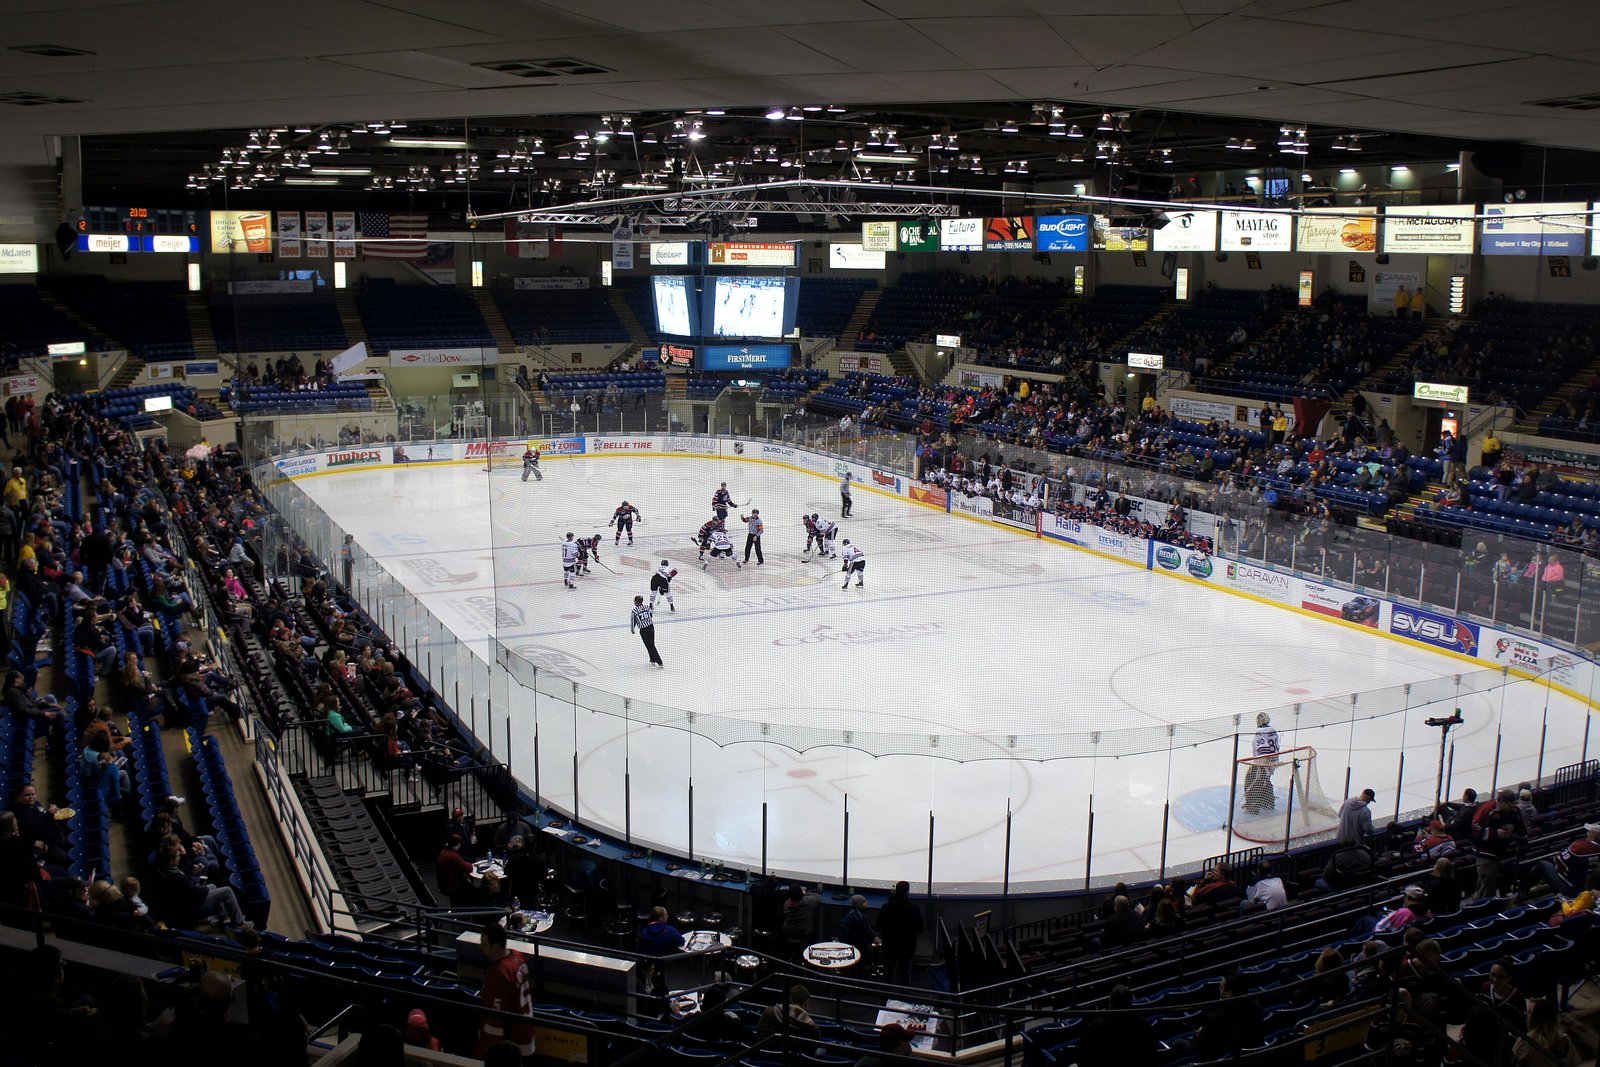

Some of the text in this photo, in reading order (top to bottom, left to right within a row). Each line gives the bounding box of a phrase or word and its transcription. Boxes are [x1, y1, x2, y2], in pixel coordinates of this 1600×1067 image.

[948, 220, 976, 233] Future
[1039, 223, 1086, 232] BUD LIGHT
[1236, 218, 1278, 231] MAYTAG
[1299, 216, 1339, 248] Harvey's
[95, 236, 121, 250] meijer
[160, 238, 183, 250] meijer
[1, 248, 31, 257] McLaren
[1381, 273, 1418, 282] CARAVAN
[1554, 266, 1568, 276] 14
[326, 450, 381, 466] Timbers
[960, 501, 992, 518] Merrill Lynch
[1190, 558, 1210, 569] REDER
[1238, 566, 1289, 589] CARAVAN
[1392, 611, 1459, 644] SVSU
[1513, 652, 1539, 665] PIZZA
